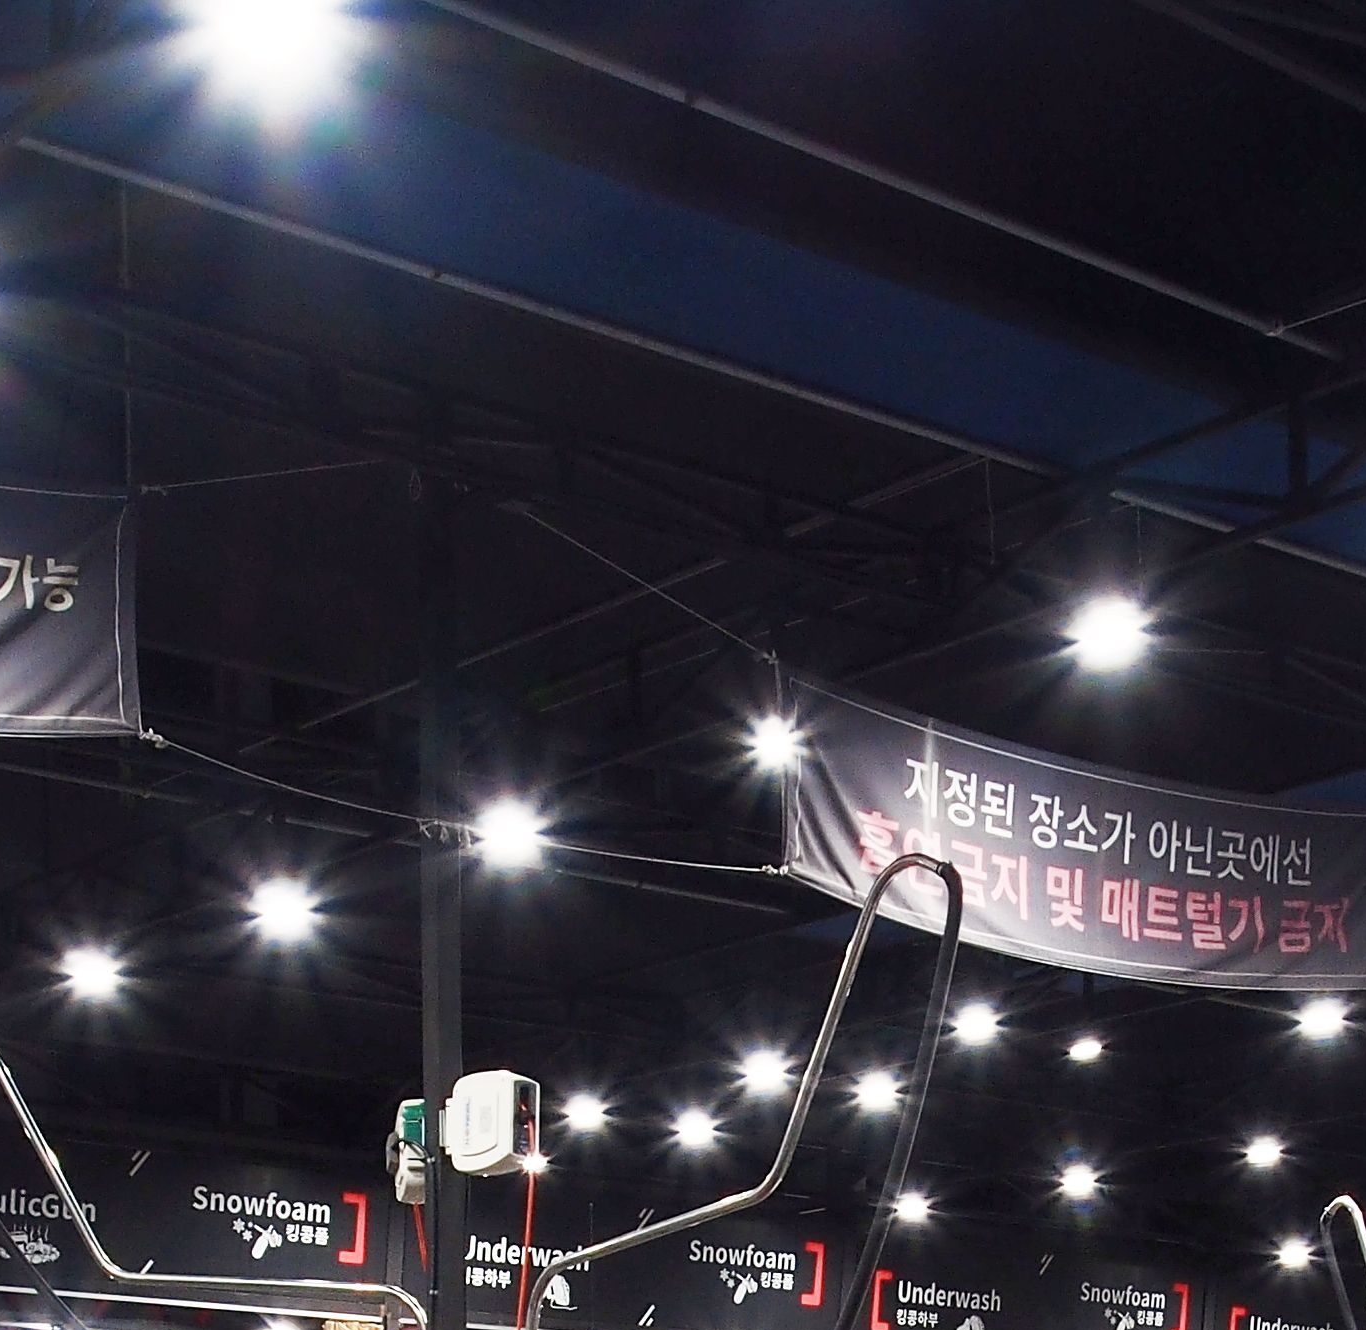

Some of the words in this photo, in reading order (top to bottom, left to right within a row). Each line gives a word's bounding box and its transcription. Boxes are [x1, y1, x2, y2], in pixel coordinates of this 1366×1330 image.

[904, 757, 1014, 838] 지정된
[1028, 791, 1136, 866] 장소가
[1148, 817, 1312, 887] 아닌곳에선
[1045, 865, 1085, 932] 및
[1100, 878, 1265, 954] 매트털기
[1278, 897, 1350, 953] 금지
[192, 1185, 331, 1224] Snowfoam
[285, 1222, 330, 1247] 킹콩폼
[689, 1239, 796, 1271] Snowfoam
[465, 1266, 512, 1289] 콩하부
[897, 1280, 1002, 1312] Underwash
[1080, 1282, 1166, 1309] Snowfoam
